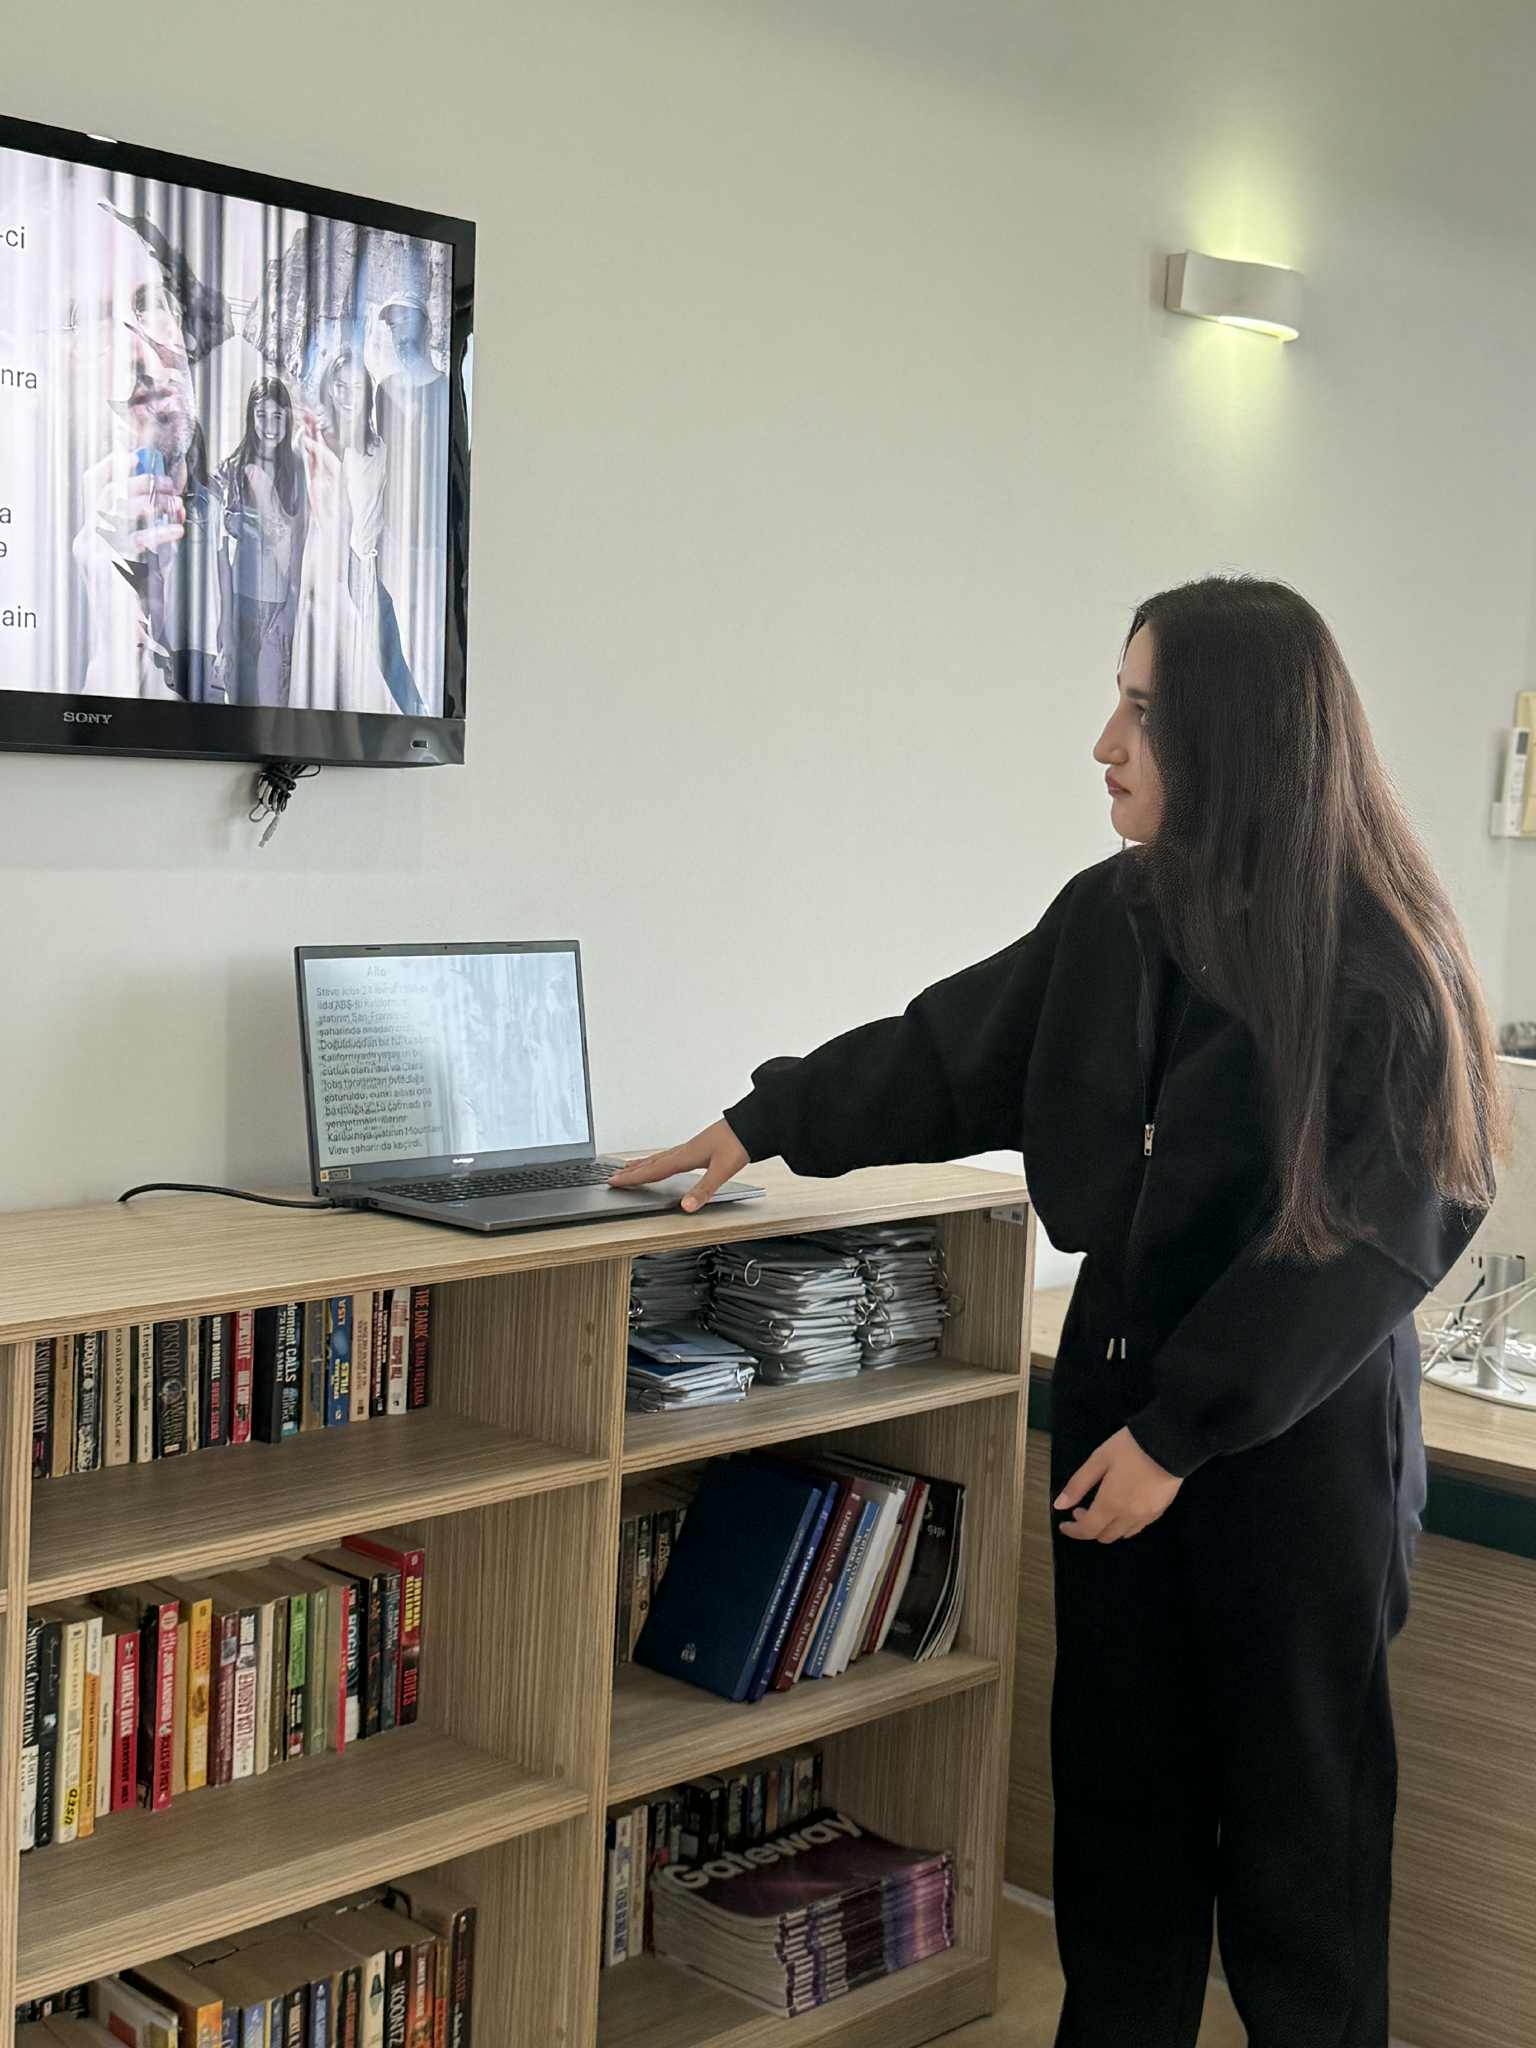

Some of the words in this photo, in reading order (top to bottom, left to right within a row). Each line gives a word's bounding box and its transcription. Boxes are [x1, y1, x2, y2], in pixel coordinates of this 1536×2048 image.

[63, 711, 113, 724] SONY
[212, 1317, 221, 1341] DAVID
[414, 1310, 429, 1339] DARK
[82, 1337, 97, 1377] KOONTZ
[161, 1322, 180, 1377] ONSOON
[211, 1343, 221, 1380] MORRELL
[285, 1348, 297, 1382] CALLS
[403, 1668, 418, 1706] BONES
[22, 1669, 40, 1746] COLLECTION
[63, 1788, 80, 1826] USED
[668, 1811, 862, 1888] Gateway
[389, 1983, 406, 2048] KOONTZ
